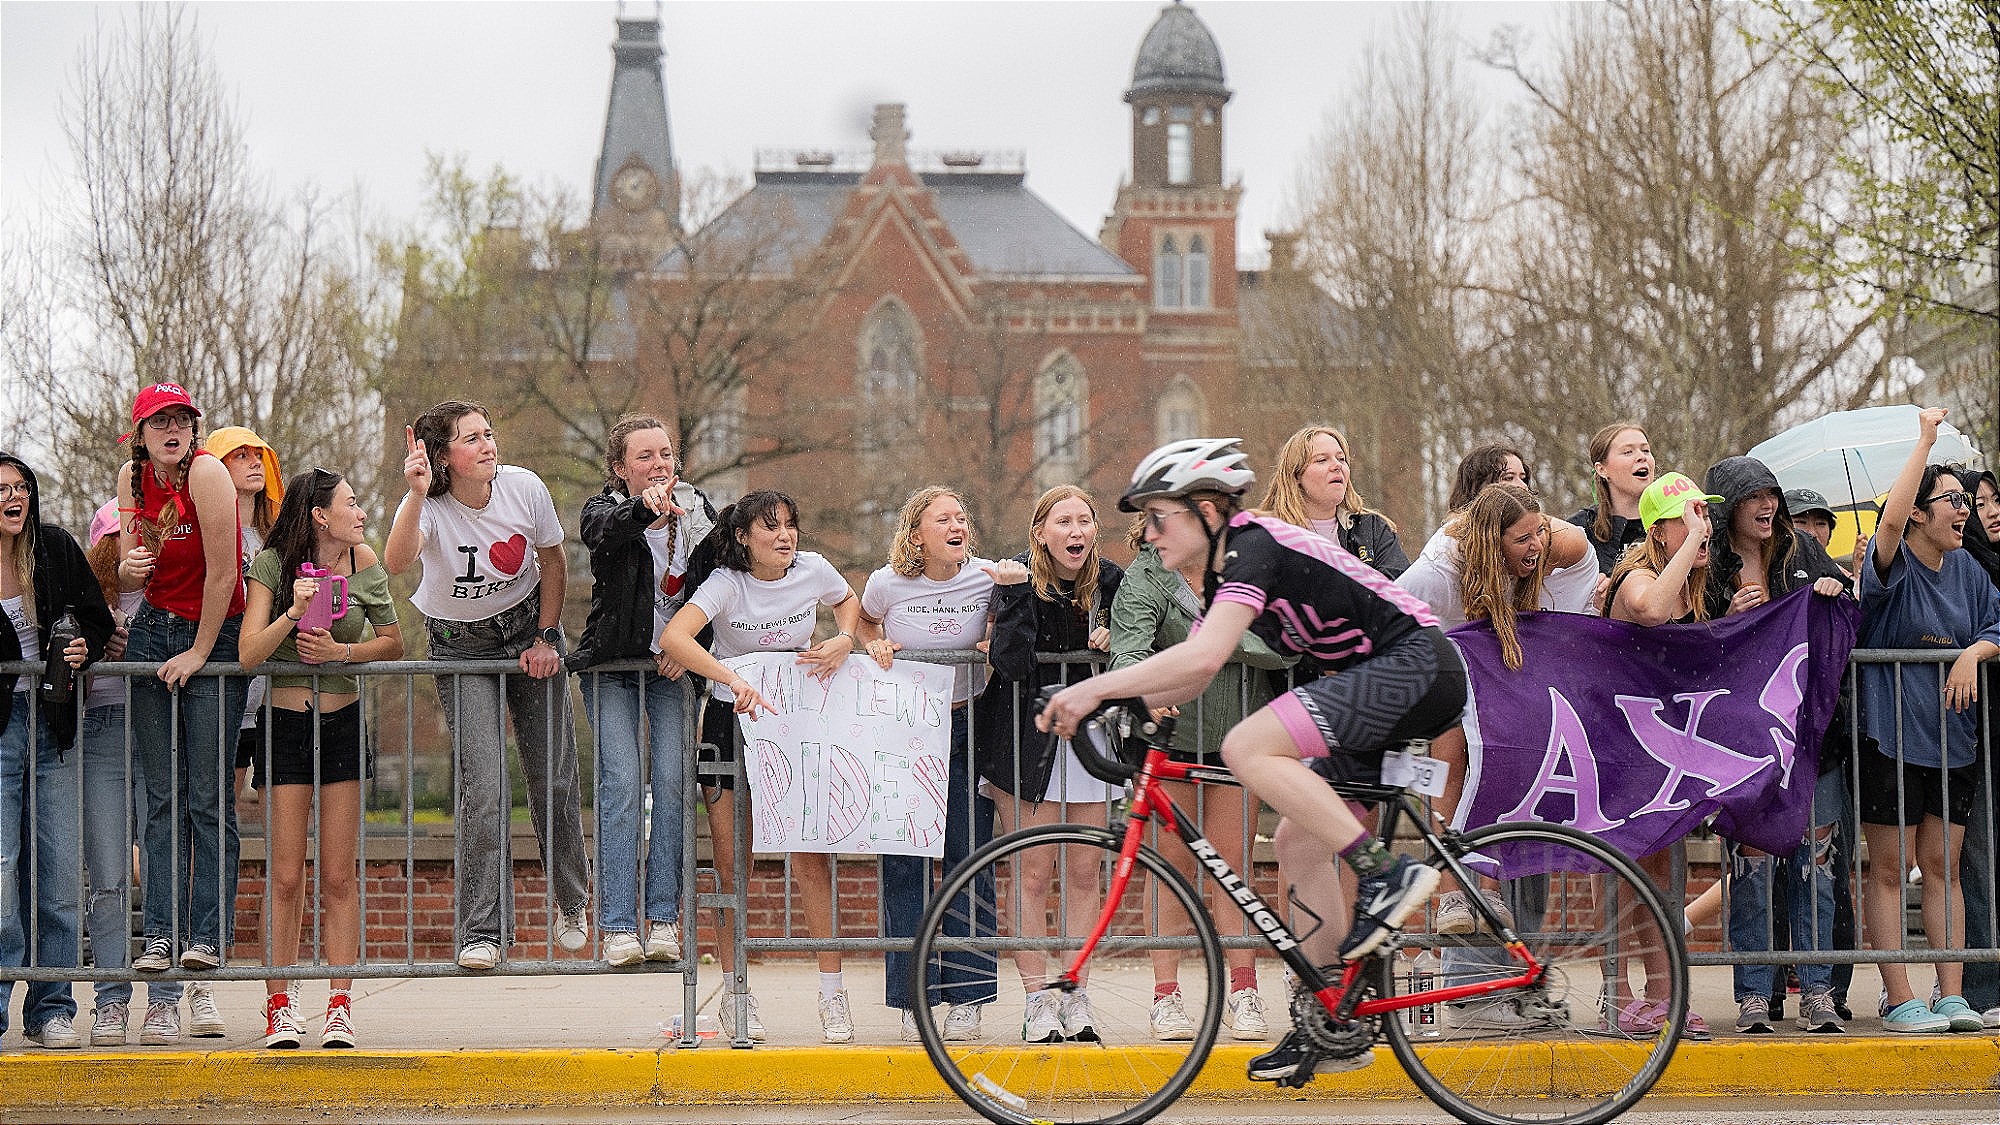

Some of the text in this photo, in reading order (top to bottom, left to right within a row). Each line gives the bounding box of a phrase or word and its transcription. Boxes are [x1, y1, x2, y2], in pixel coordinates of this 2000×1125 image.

[455, 545, 485, 583] I
[731, 609, 811, 631] EMILY LEWIS RIDES
[855, 678, 944, 727] LEWIS
[756, 738, 949, 848] RIDES
[1187, 839, 1298, 951] RALEIGH
